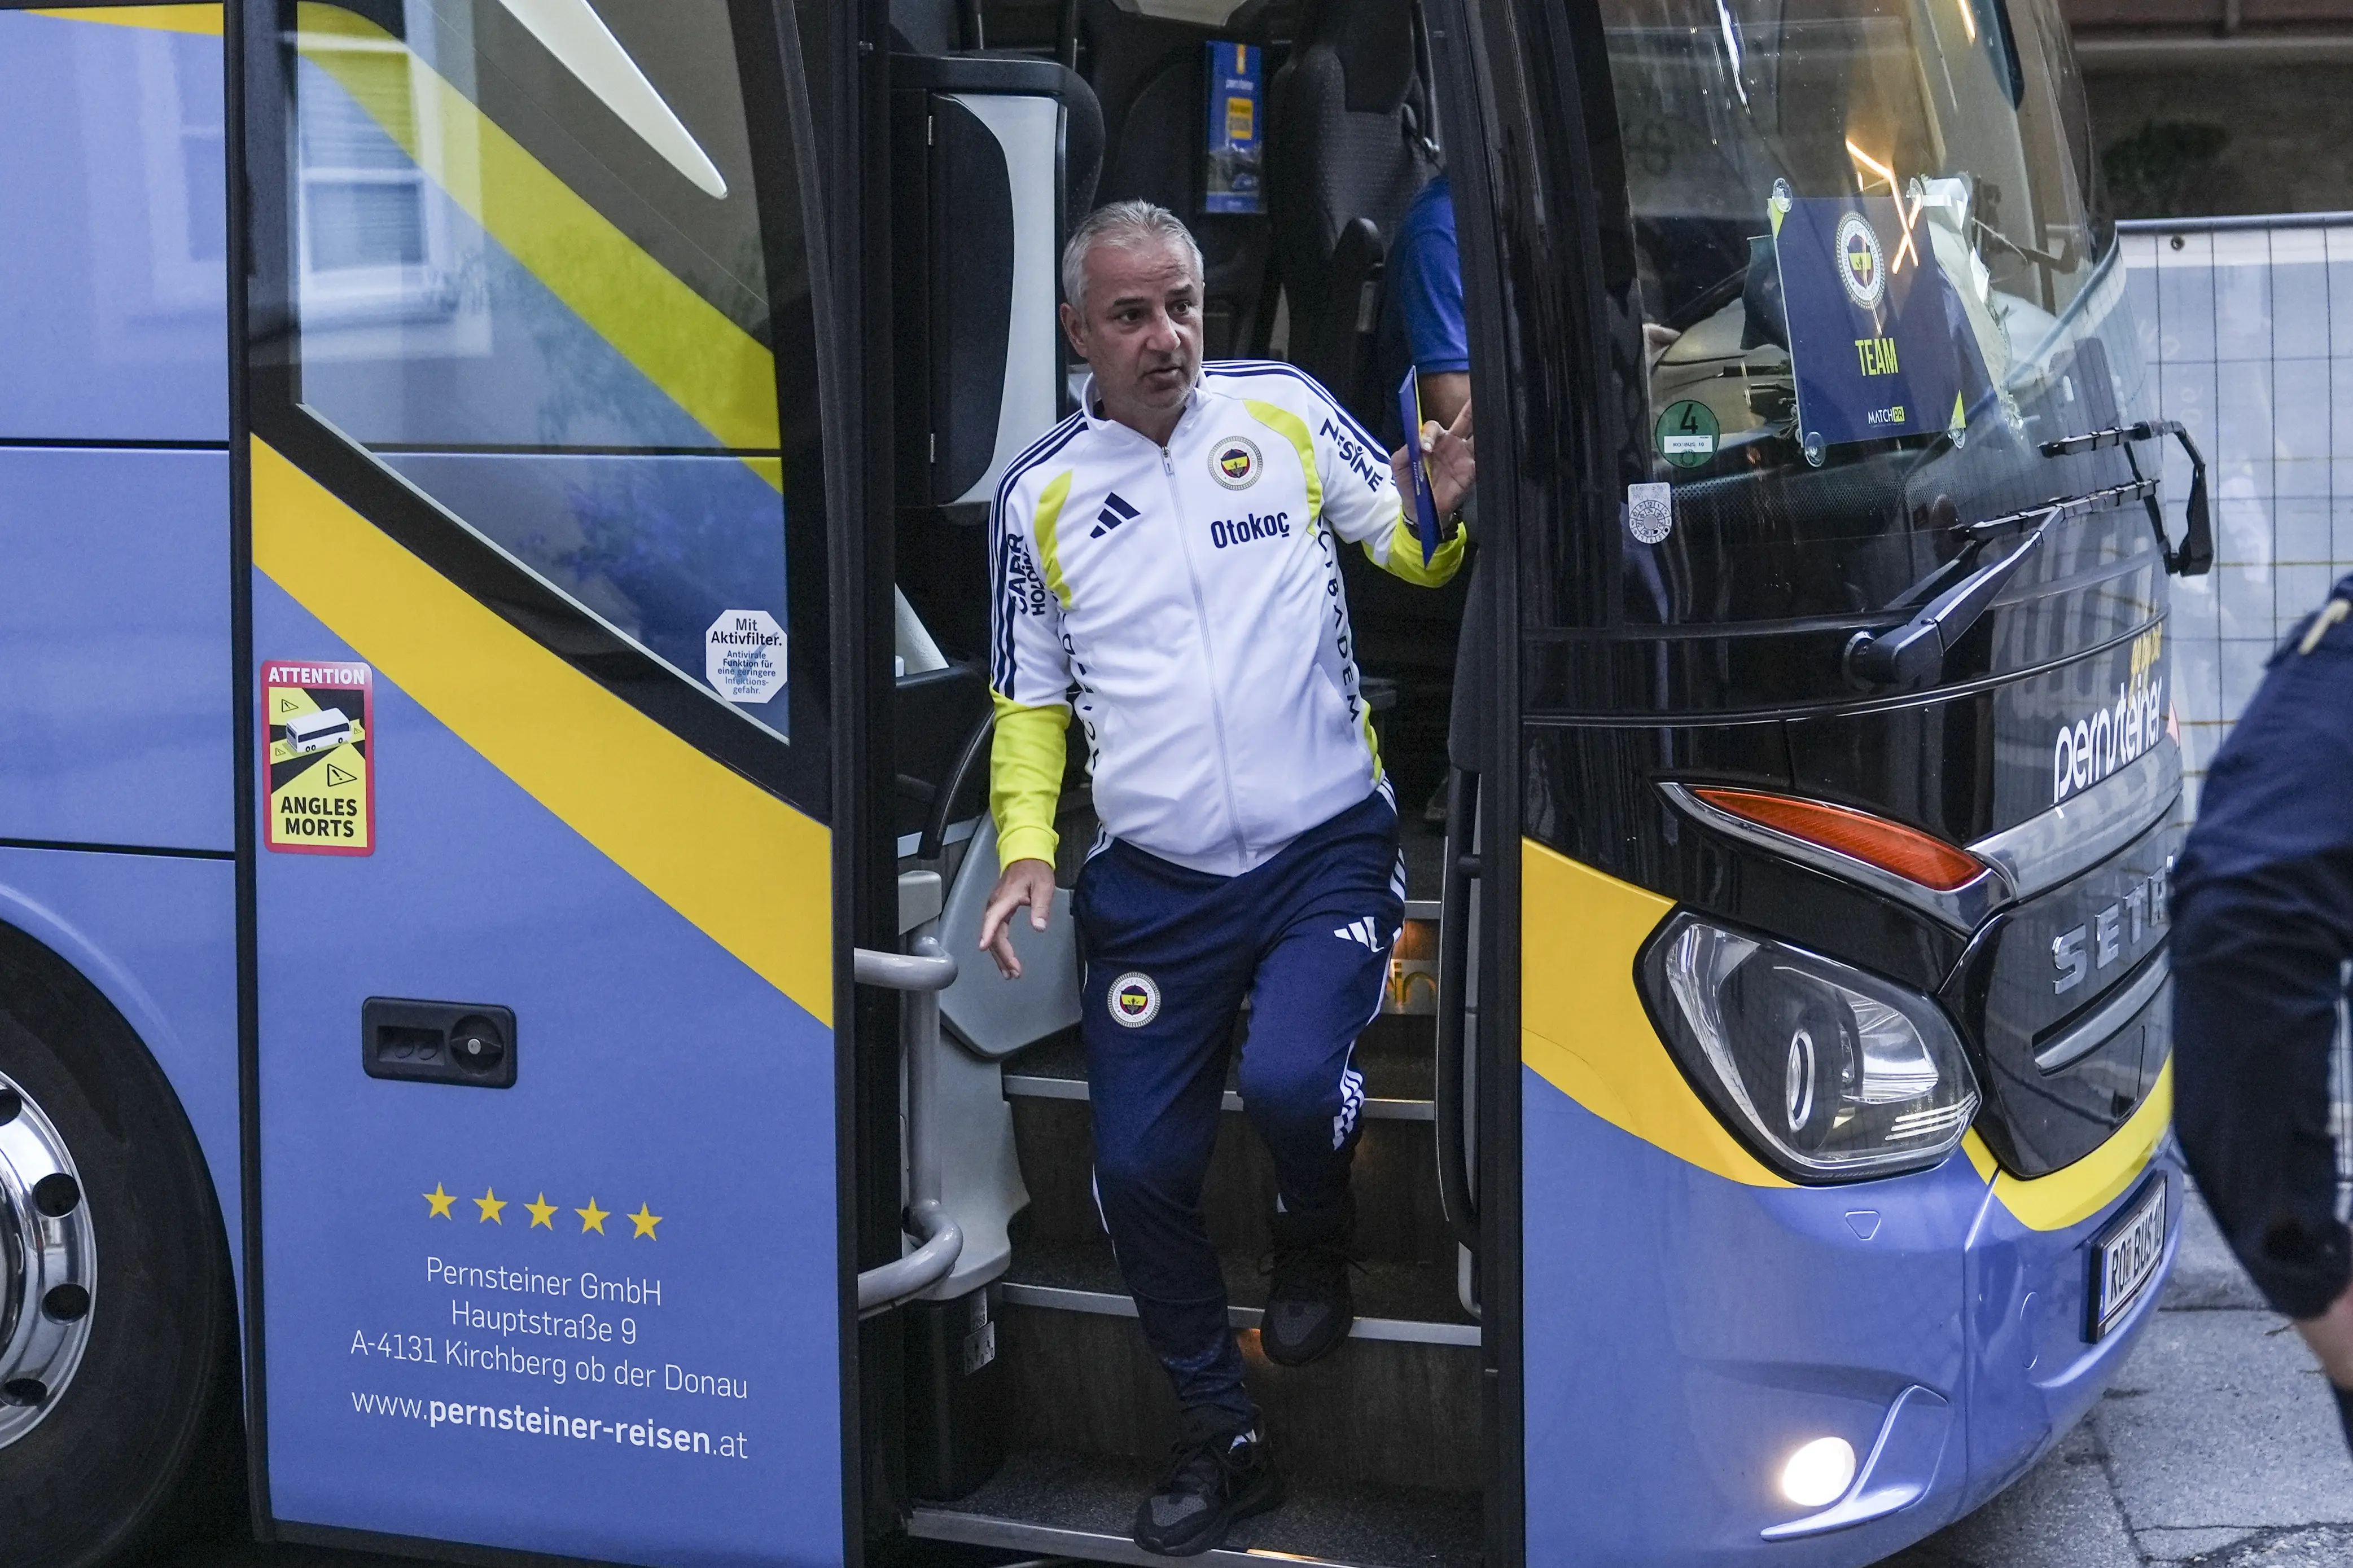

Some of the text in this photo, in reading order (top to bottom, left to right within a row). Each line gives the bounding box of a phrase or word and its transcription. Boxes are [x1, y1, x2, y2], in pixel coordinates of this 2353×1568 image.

[1855, 338, 1899, 376] TEAM
[1680, 403, 1698, 434] 4
[1210, 512, 1290, 548] Otokoç
[736, 618, 757, 631] Mit
[1317, 512, 1359, 723] CIBADEM
[711, 631, 782, 647] Aktivfilter.
[727, 650, 766, 659] Antivirale
[268, 667, 365, 685] ATTENTION
[723, 658, 773, 668] Funktion für
[737, 669, 776, 678] geringere
[733, 686, 761, 695] gefahr.
[281, 796, 357, 816] ANGLES
[286, 818, 354, 838] MORTS
[2052, 855, 2174, 995] SETR
[2110, 1240, 2126, 1303] RO
[2133, 1211, 2153, 1279] BUS
[427, 1256, 661, 1306] Pernsteiner GmbH
[452, 1299, 637, 1345] Hauptstraße 9
[350, 1329, 747, 1399] A-4131 Kirchberg ob der Donau
[351, 1391, 748, 1459] www.pernsteiner-reisen.at
